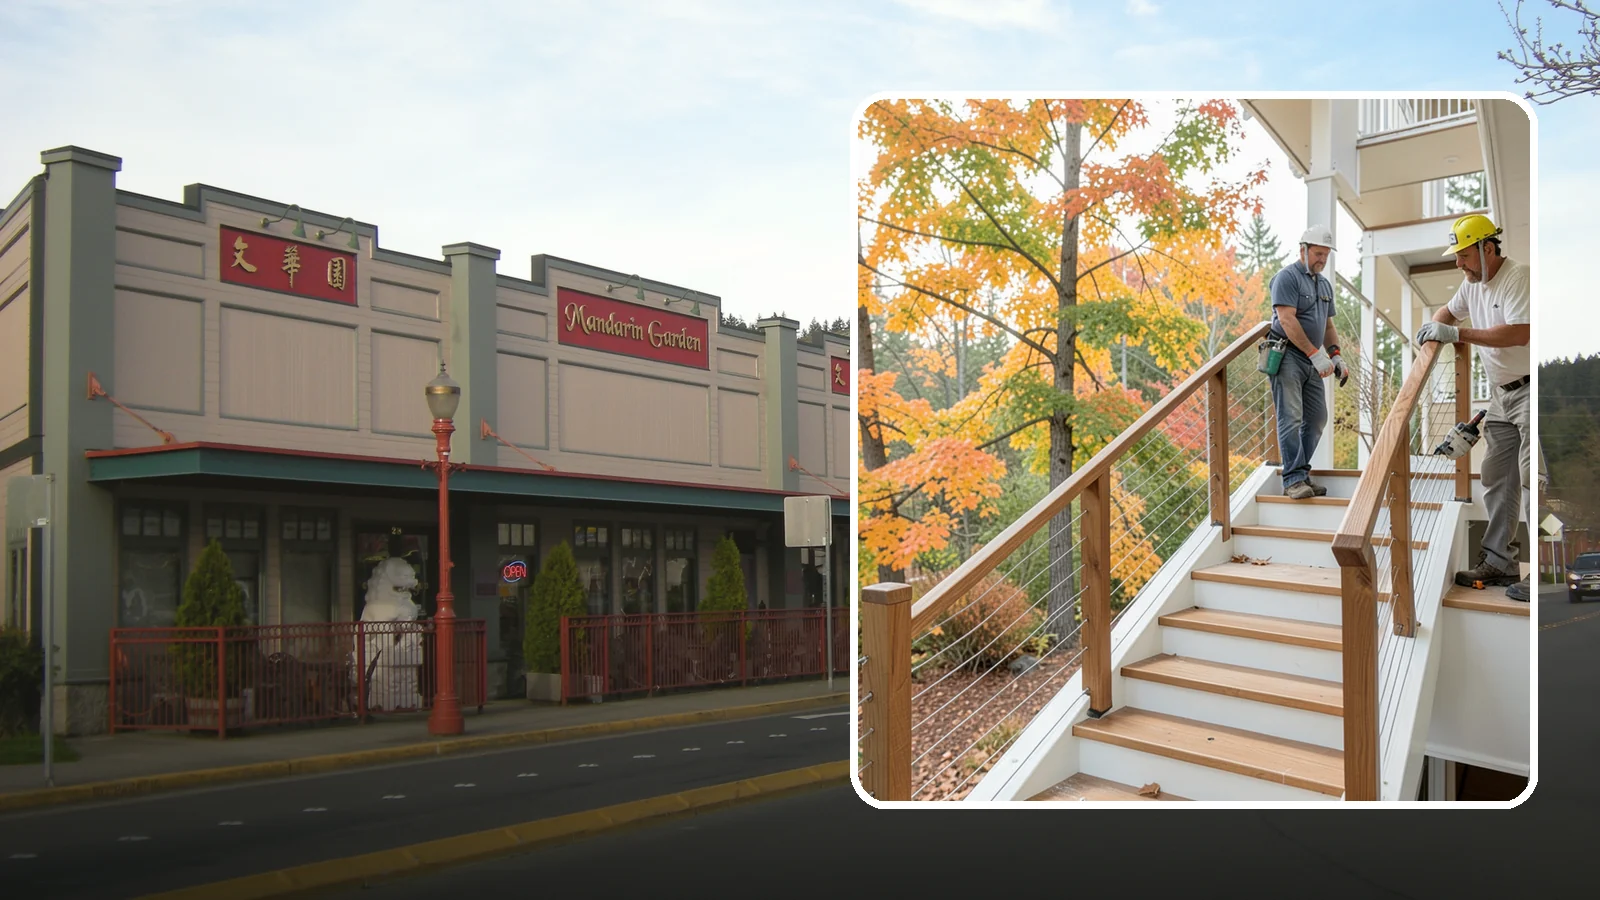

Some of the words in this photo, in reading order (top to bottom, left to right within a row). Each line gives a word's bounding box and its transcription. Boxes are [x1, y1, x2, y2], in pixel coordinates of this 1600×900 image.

[564, 302, 644, 341] Mandarin
[648, 320, 702, 352] Garden
[503, 565, 527, 578] OPEN
